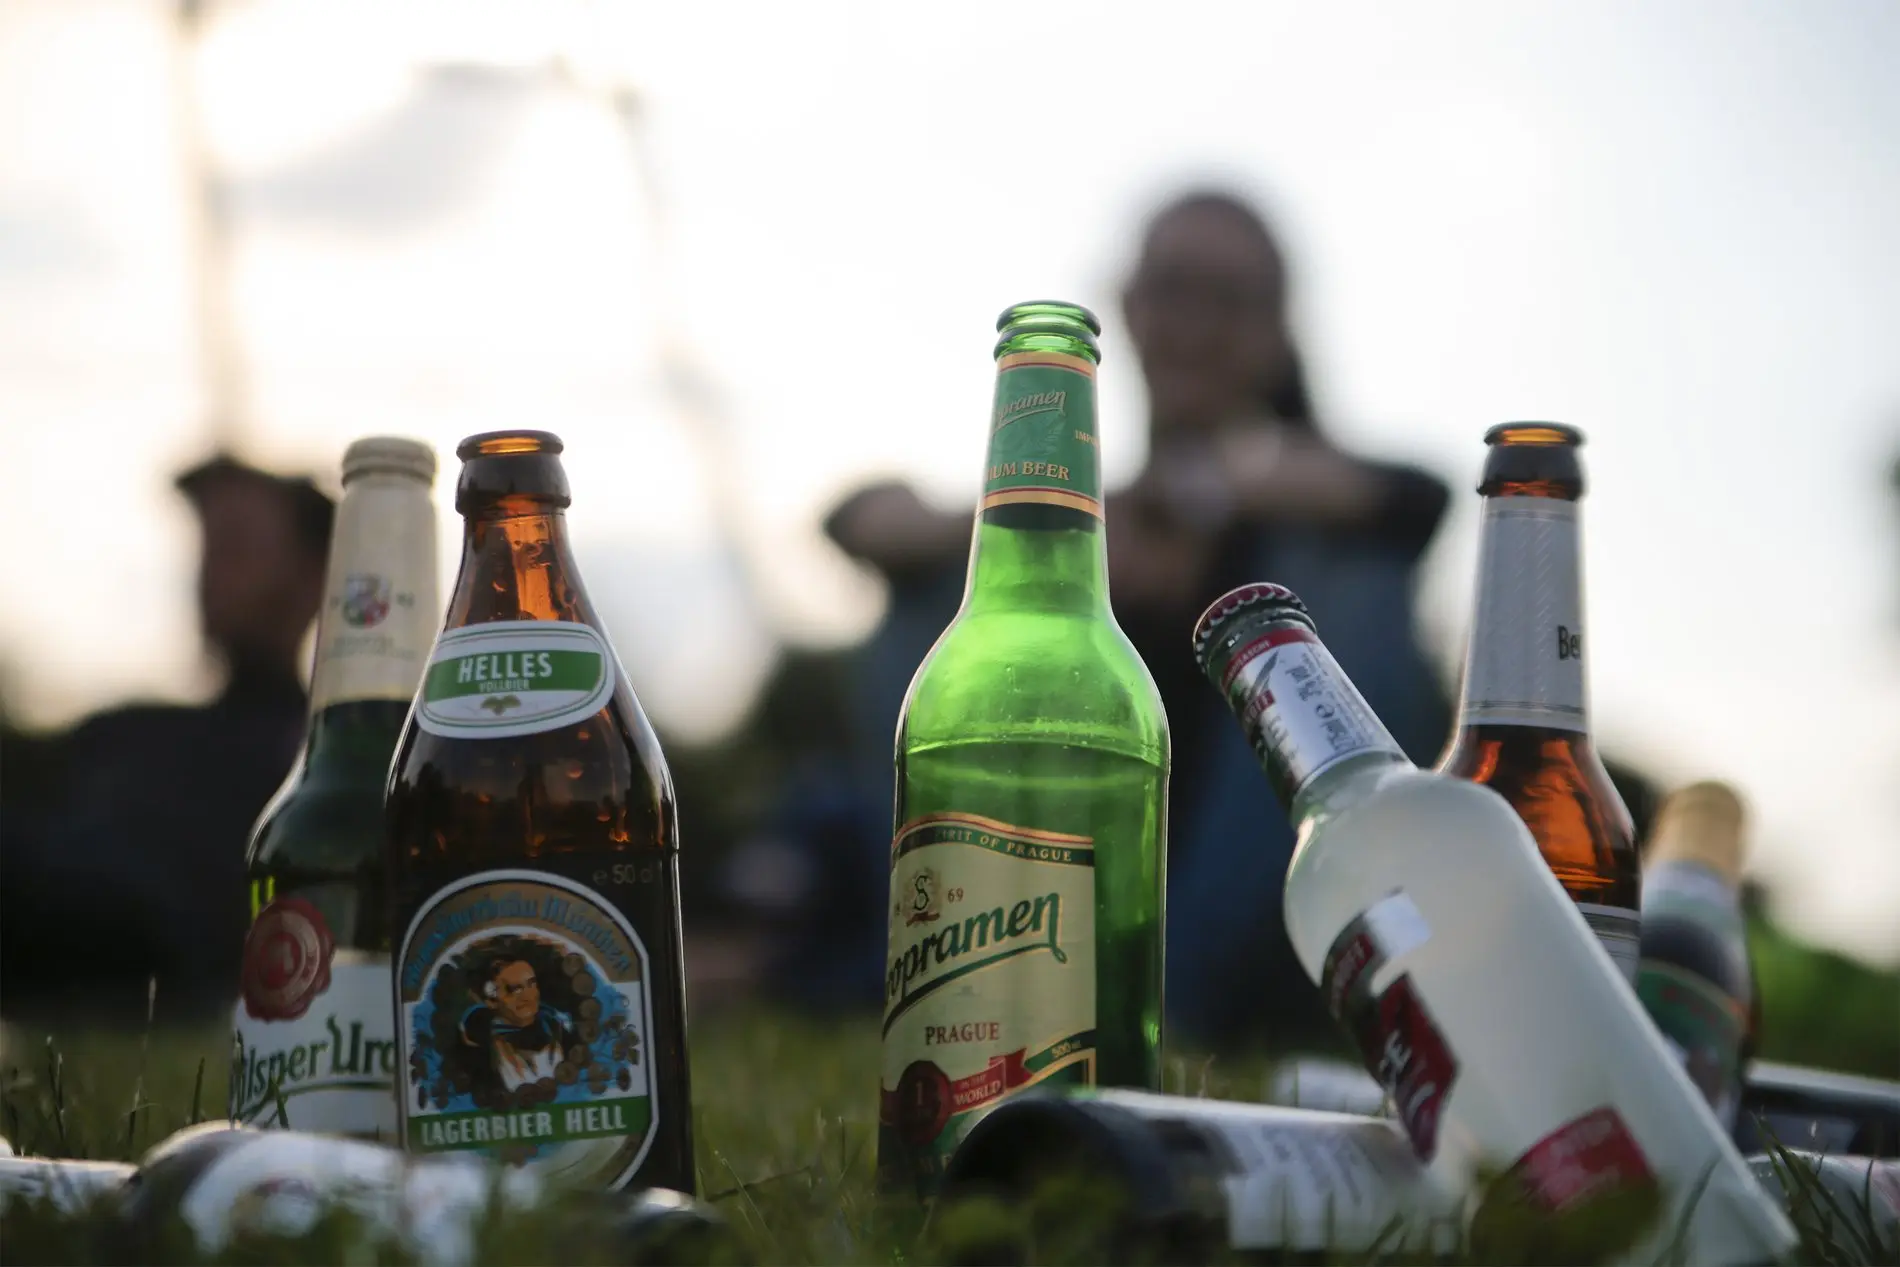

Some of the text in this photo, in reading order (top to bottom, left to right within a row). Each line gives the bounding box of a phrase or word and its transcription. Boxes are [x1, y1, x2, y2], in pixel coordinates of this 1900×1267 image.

[988, 461, 1070, 481] IUM BEER
[1557, 625, 1582, 661] Be
[458, 653, 553, 683] HELLES
[936, 831, 1072, 862] IRIT OF PRAGUE
[612, 863, 635, 884] 50
[887, 892, 1067, 1000] opramen
[925, 1022, 1000, 1045] PRAGUE
[954, 1079, 1001, 1107] WORLD
[421, 1105, 627, 1146] LAGERBIER HELL
